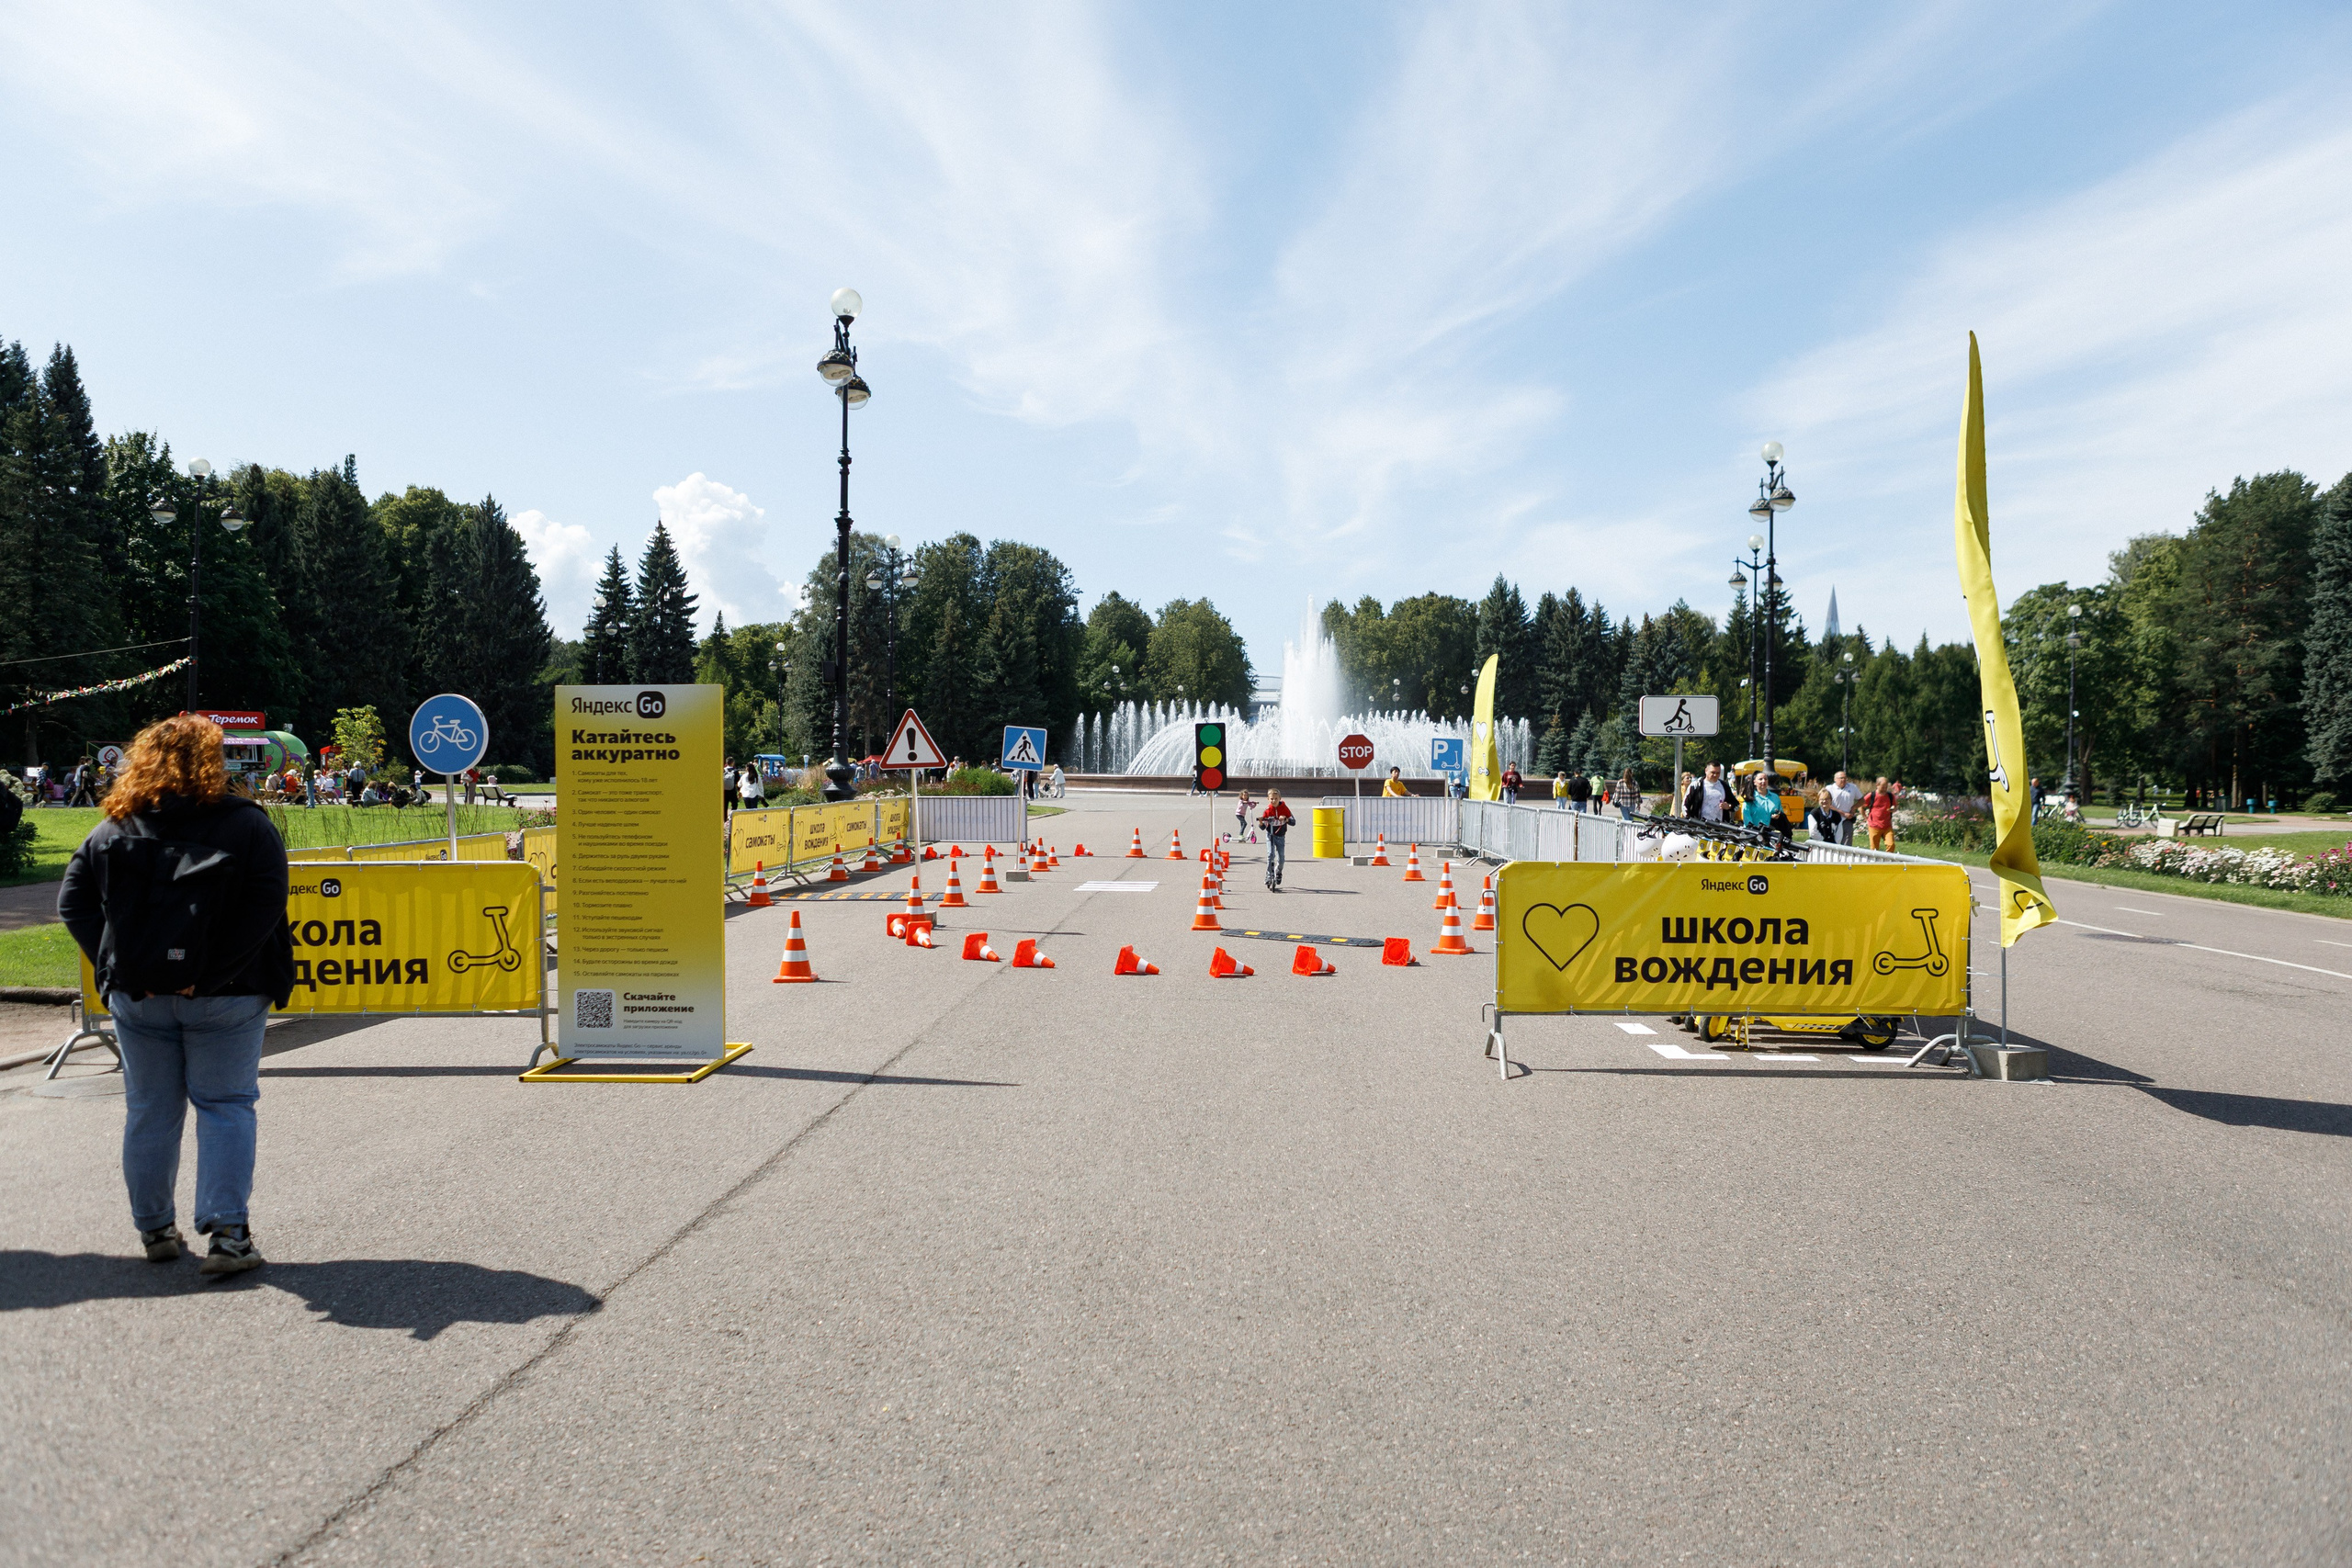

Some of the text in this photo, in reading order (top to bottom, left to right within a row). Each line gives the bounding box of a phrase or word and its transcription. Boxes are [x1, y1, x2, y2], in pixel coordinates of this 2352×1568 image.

[572, 695, 663, 715] Яндекс Go
[208, 714, 258, 725] Теремок
[572, 729, 676, 744] Катайтесь
[572, 749, 680, 763] аккуратно
[1340, 746, 1373, 758] STOP
[1433, 740, 1448, 760] P
[810, 823, 825, 834] школа
[746, 834, 775, 848] самокаты
[805, 837, 828, 851] вождения
[288, 881, 340, 895] декс Go
[1701, 877, 1767, 893] Яндекс Go
[290, 919, 382, 946] кола
[1661, 917, 1809, 945] школа
[294, 959, 429, 992] дения
[1614, 956, 1853, 991] вождения
[623, 992, 676, 1001] Скачайте
